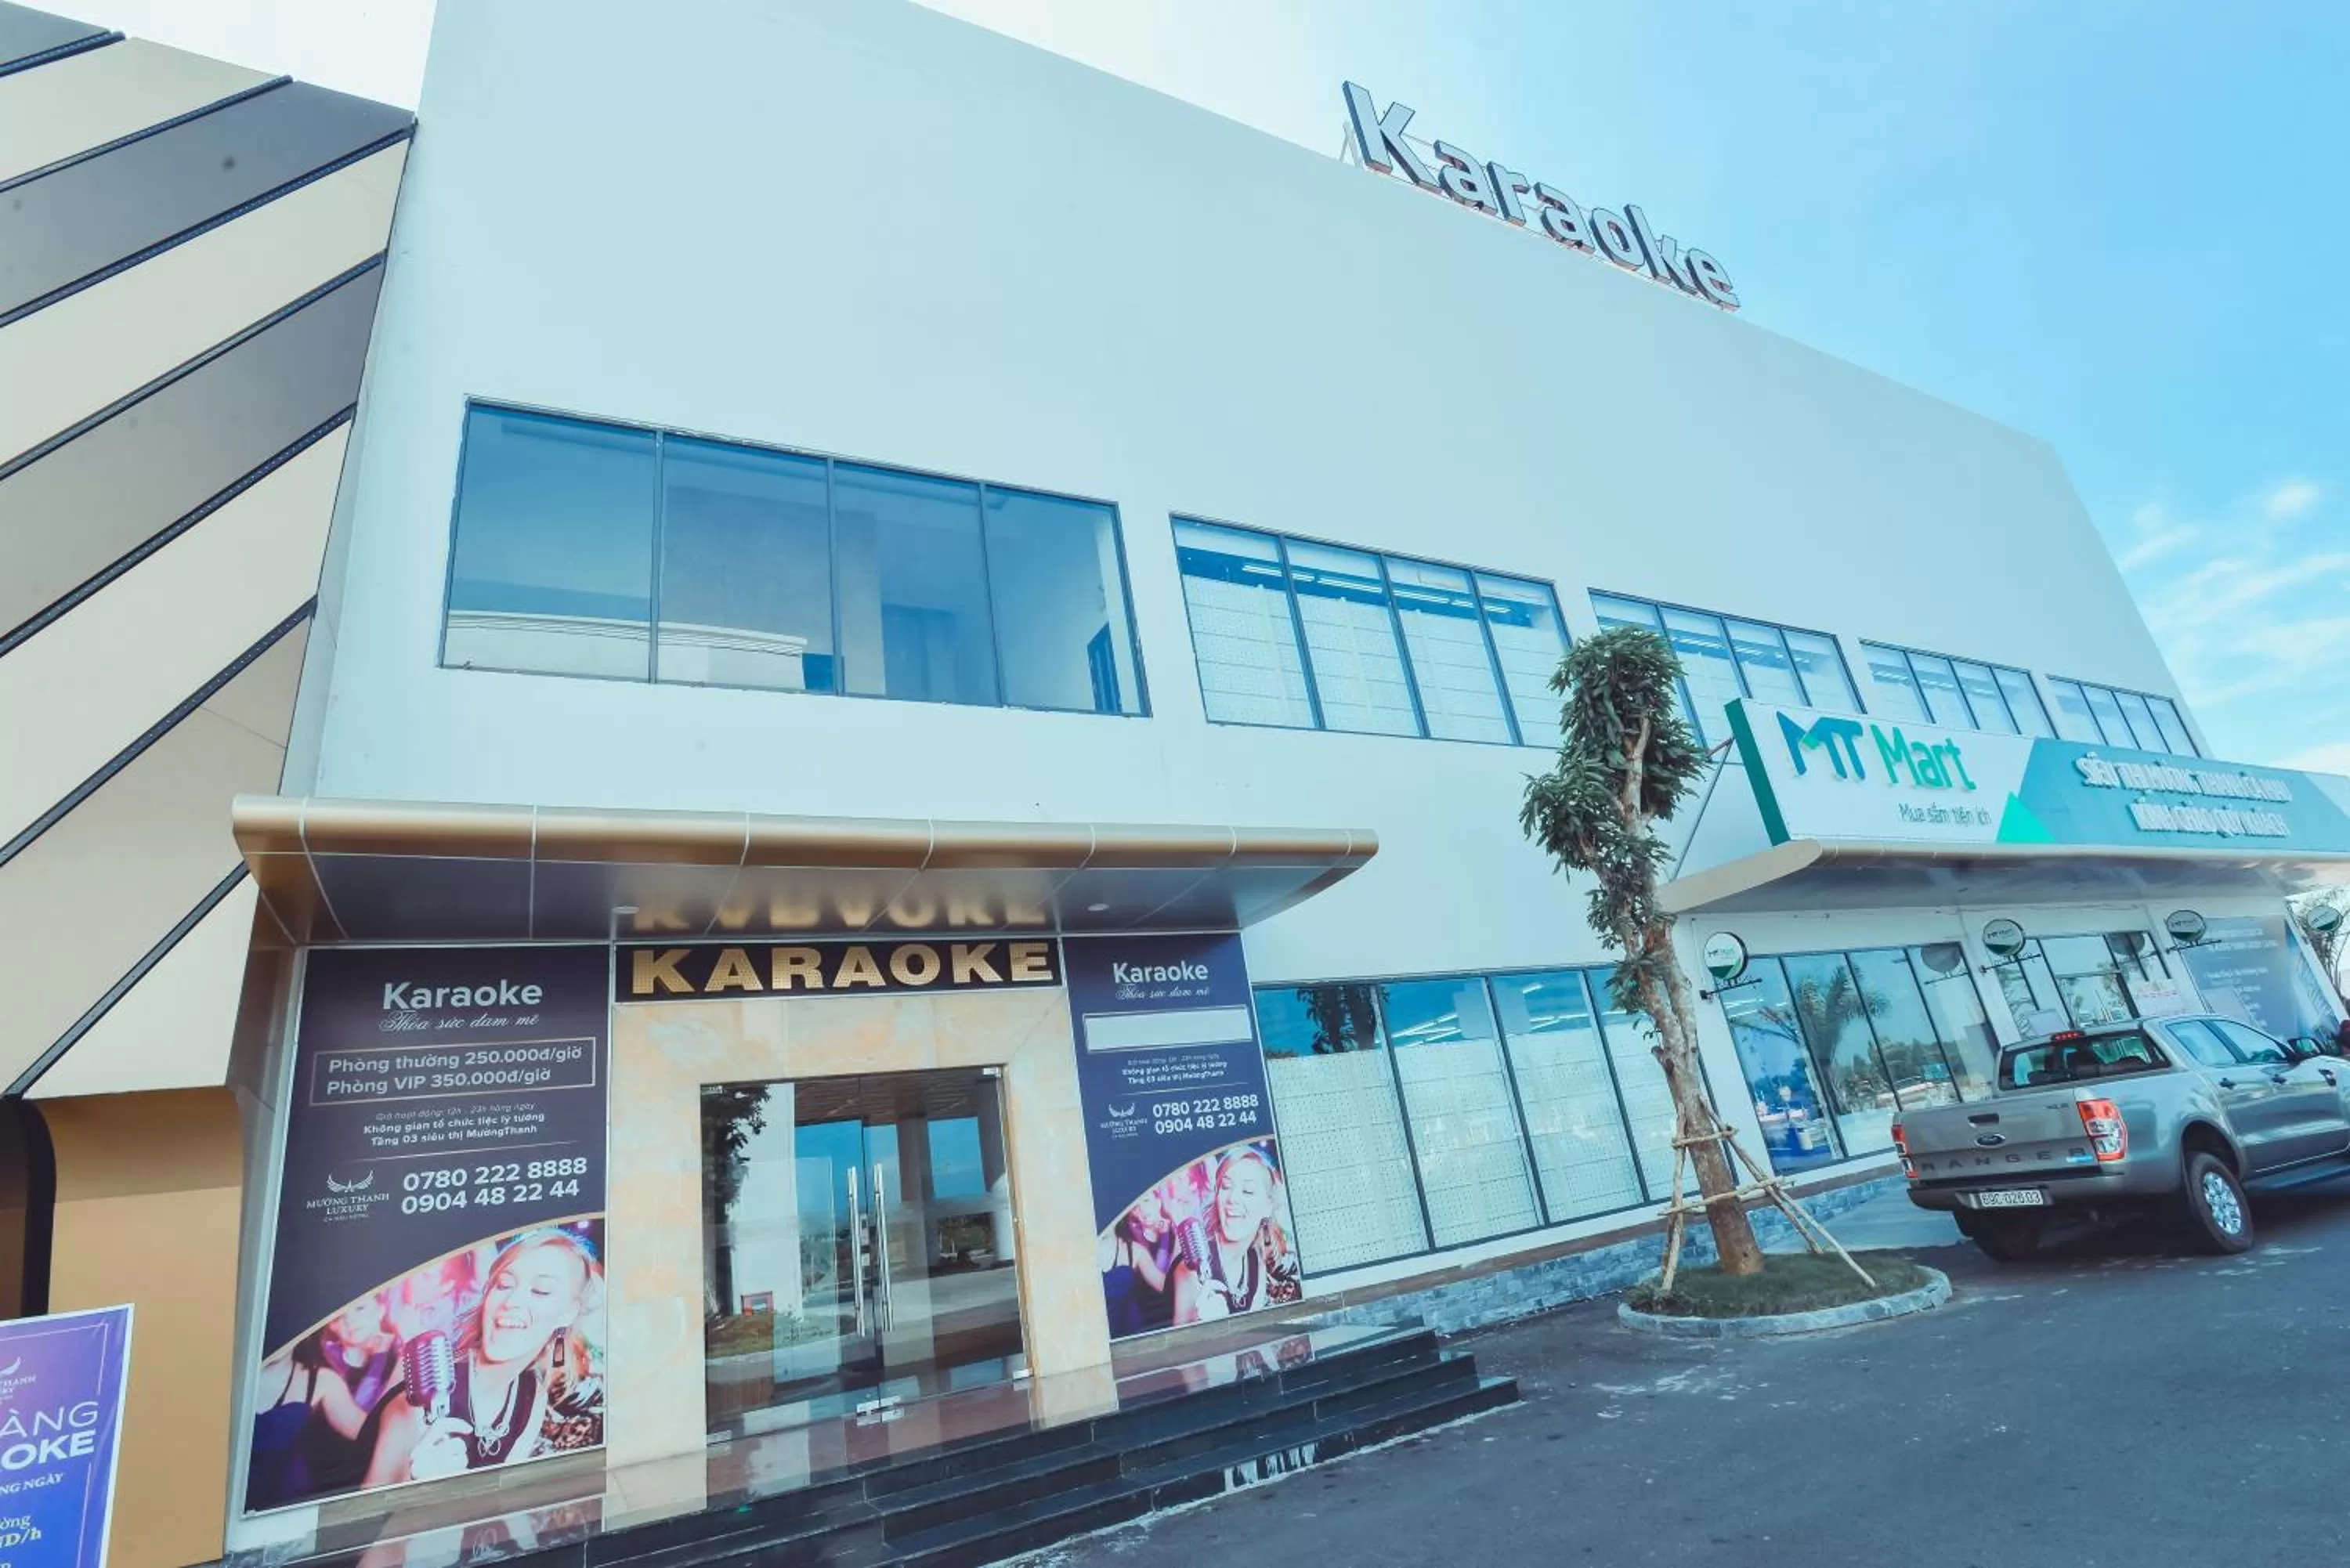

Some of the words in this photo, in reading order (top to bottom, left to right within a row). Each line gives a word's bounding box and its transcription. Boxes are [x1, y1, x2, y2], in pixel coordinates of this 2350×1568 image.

[1343, 80, 1741, 312] Karaoke
[1870, 723, 1977, 790] Mart
[632, 942, 1054, 994] KARAOKE
[1112, 959, 1209, 984] Karaoke
[383, 979, 543, 1010] Karaoke
[329, 1055, 389, 1074] Phòng
[395, 1051, 459, 1071] thường
[465, 1045, 582, 1067] 250.000đ/giờ
[327, 1075, 388, 1095] Phòng
[394, 1076, 426, 1091] VIP
[431, 1068, 551, 1089] 350.000đ/giờ
[1153, 1101, 1190, 1118] 0780
[1193, 1098, 1220, 1113] 222
[1224, 1094, 1259, 1111] 8888
[363, 1124, 401, 1134] Không
[404, 1122, 430, 1133] gian
[1155, 1118, 1193, 1135] 0904
[1196, 1115, 1215, 1129] 48
[1218, 1113, 1236, 1127] 22
[1239, 1110, 1256, 1124] 44
[402, 1133, 418, 1143] 03
[1921, 1147, 2085, 1172] RANGER
[403, 1168, 468, 1191] 0780
[474, 1163, 521, 1185] 222
[527, 1157, 588, 1179] 8888
[349, 1192, 389, 1204] THANH
[401, 1190, 468, 1214] 0904
[474, 1187, 505, 1206] 48
[512, 1183, 543, 1202] 22
[550, 1179, 580, 1198] 44
[326, 1204, 369, 1216] LUXURY
[22, 1472, 63, 1491] NGÀY
